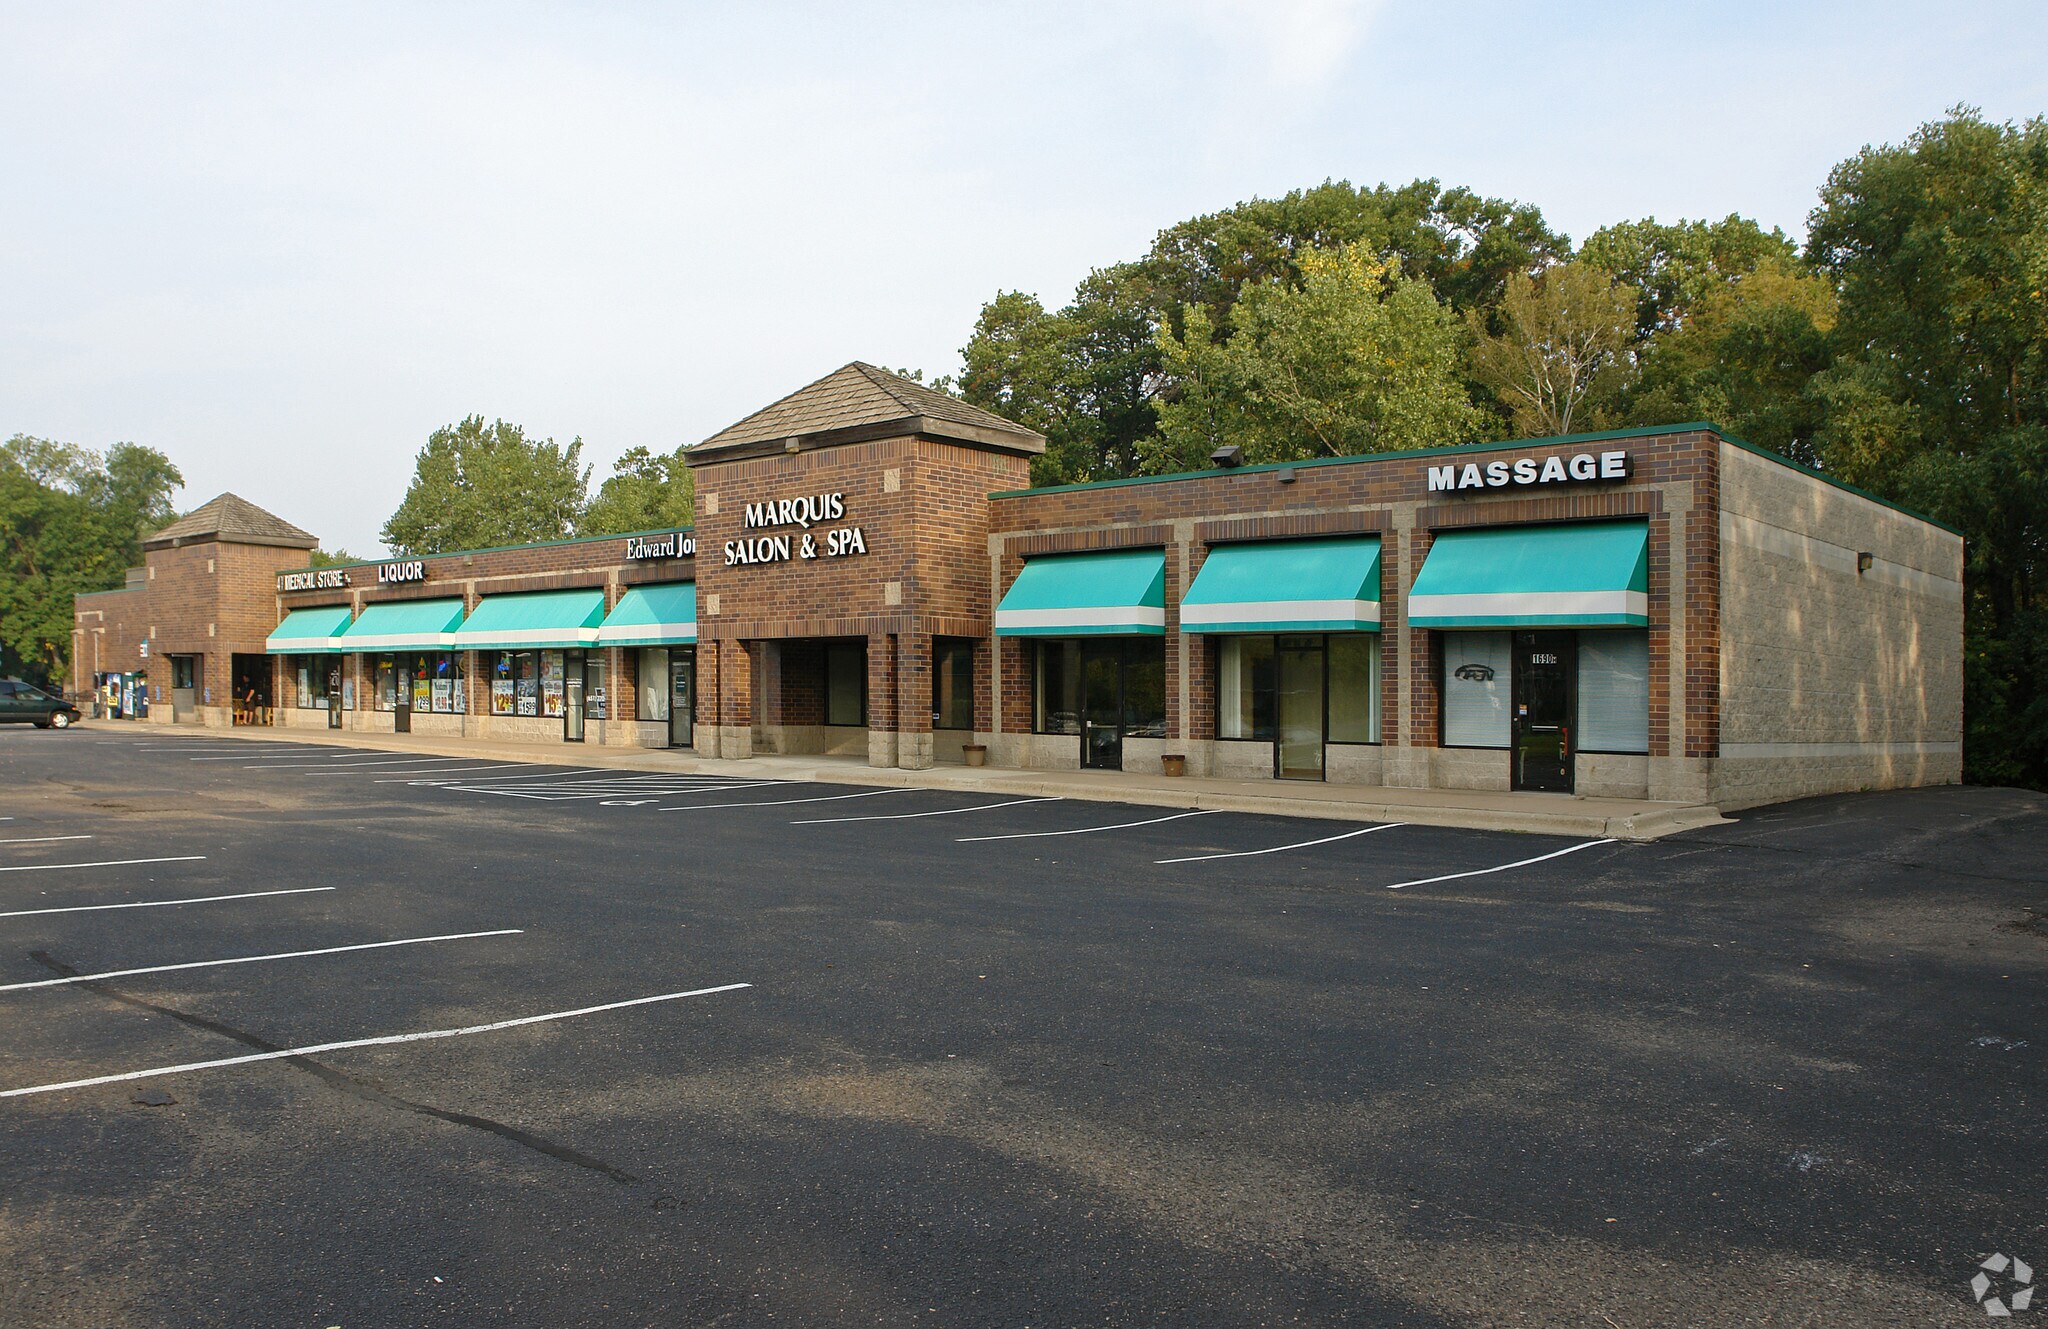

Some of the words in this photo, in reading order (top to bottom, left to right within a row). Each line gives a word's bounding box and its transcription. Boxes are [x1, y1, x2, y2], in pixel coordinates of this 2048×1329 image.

[1428, 450, 1626, 491] MASSAGE
[744, 493, 844, 528] MARQUIS
[625, 533, 674, 561] Edward
[724, 535, 790, 566] SALON
[800, 533, 816, 559] &
[827, 527, 866, 556] SPA
[284, 572, 315, 591] MEDICAL
[317, 570, 343, 588] STORE
[378, 561, 423, 583] LIQUOR
